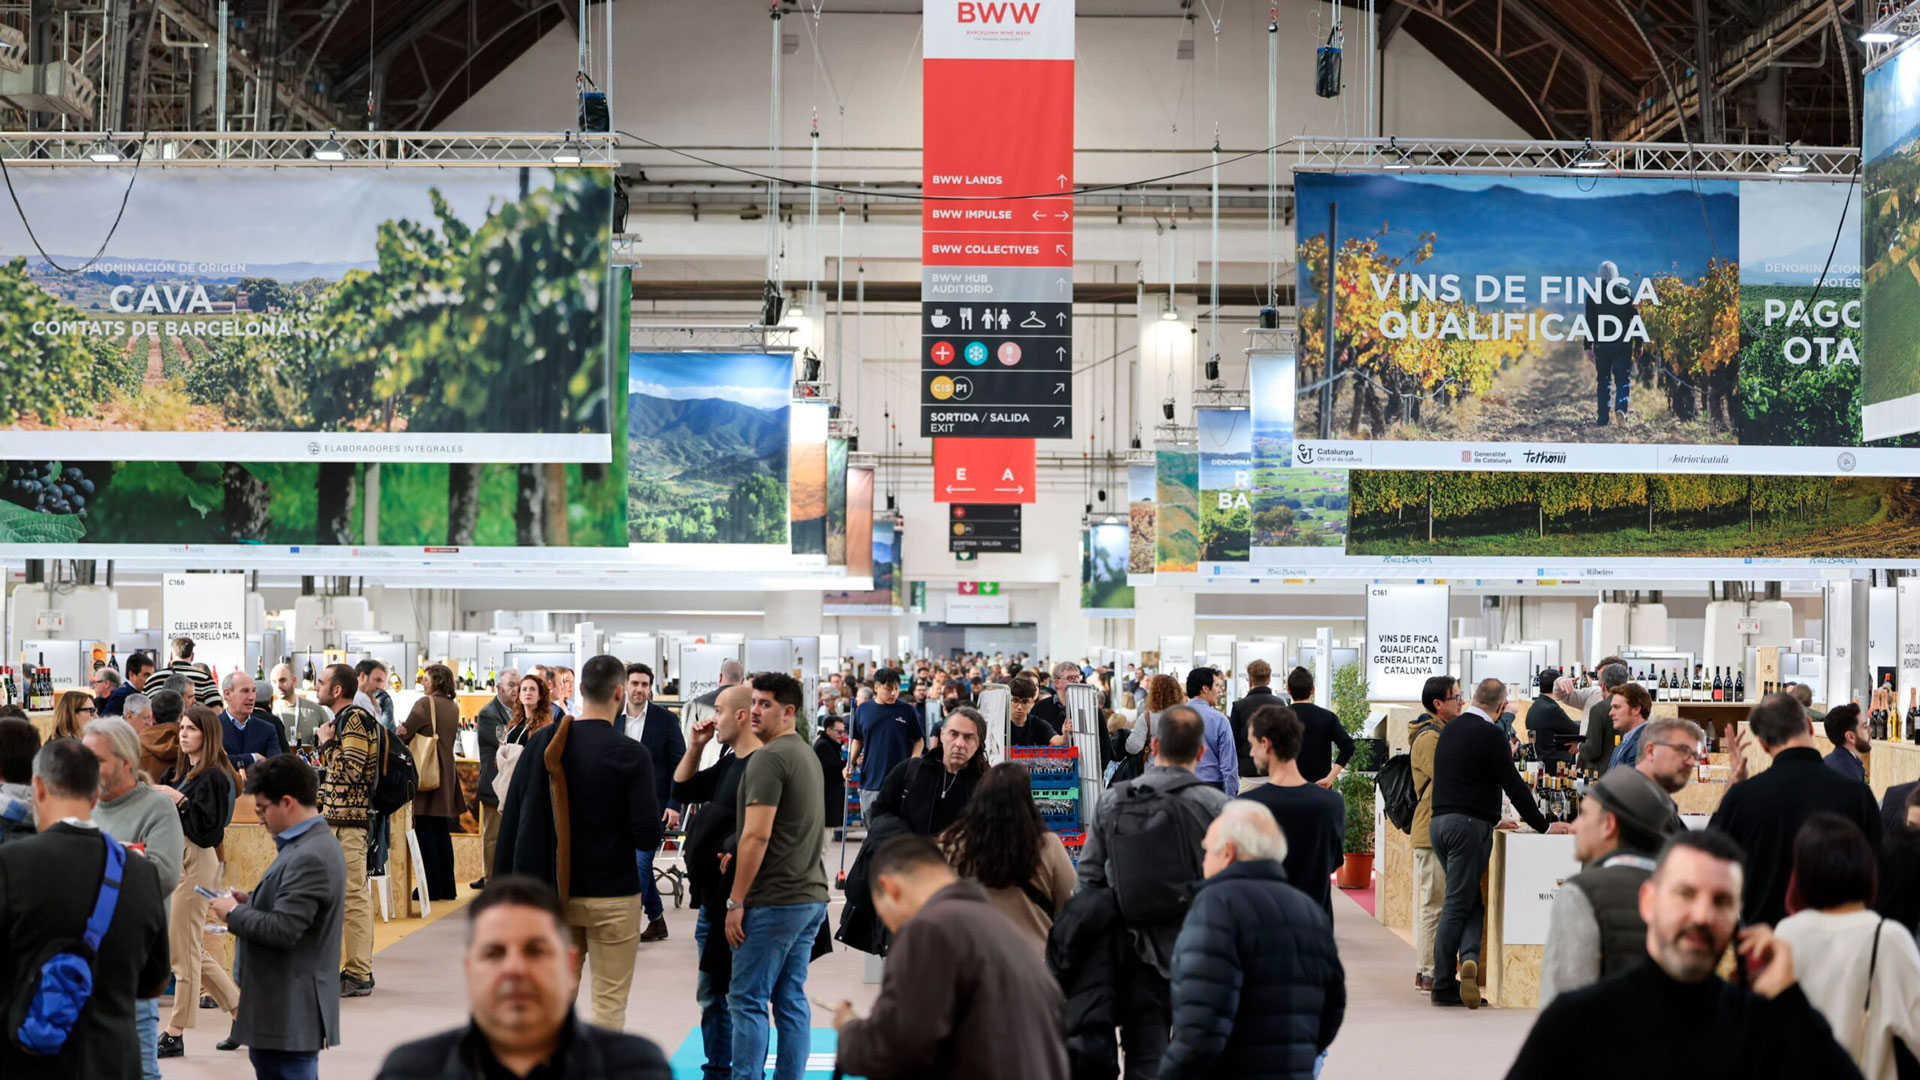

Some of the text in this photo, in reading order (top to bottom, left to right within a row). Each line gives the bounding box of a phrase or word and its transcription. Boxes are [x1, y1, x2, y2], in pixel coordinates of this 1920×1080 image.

[958, 2, 1040, 24] BWW
[932, 175, 1003, 184] BWW LANDS
[932, 210, 1012, 219] BWW IMPULSE
[932, 244, 1039, 254] BWW COLLECTIVES
[78, 262, 246, 273] DENOMINACIÓN DE ORIGEN
[1765, 262, 1860, 274] DENOMINACIÓN
[932, 273, 988, 283] BWW HUB
[932, 284, 993, 294] AUDITORIO
[1370, 274, 1660, 306] VINS DE FINCA
[110, 285, 214, 313] CAVA
[32, 320, 291, 337] COMTATS DE BARCELONA
[1378, 311, 1650, 343] QUALIFICADA
[956, 384, 967, 393] P1
[930, 412, 1030, 423] SORTIDA / SALIDA
[930, 424, 955, 433] EXIT
[404, 445, 464, 453] INTEGRALES
[1317, 448, 1354, 456] Catalunya
[956, 468, 1014, 481] E A
[175, 622, 232, 630] CELLER KRIPTA DE
[192, 632, 221, 640] TORELLÓ
[1379, 635, 1398, 643] VINS
[1380, 645, 1437, 654] QUALIFICADA
[1374, 656, 1429, 664] GENERALITAT
